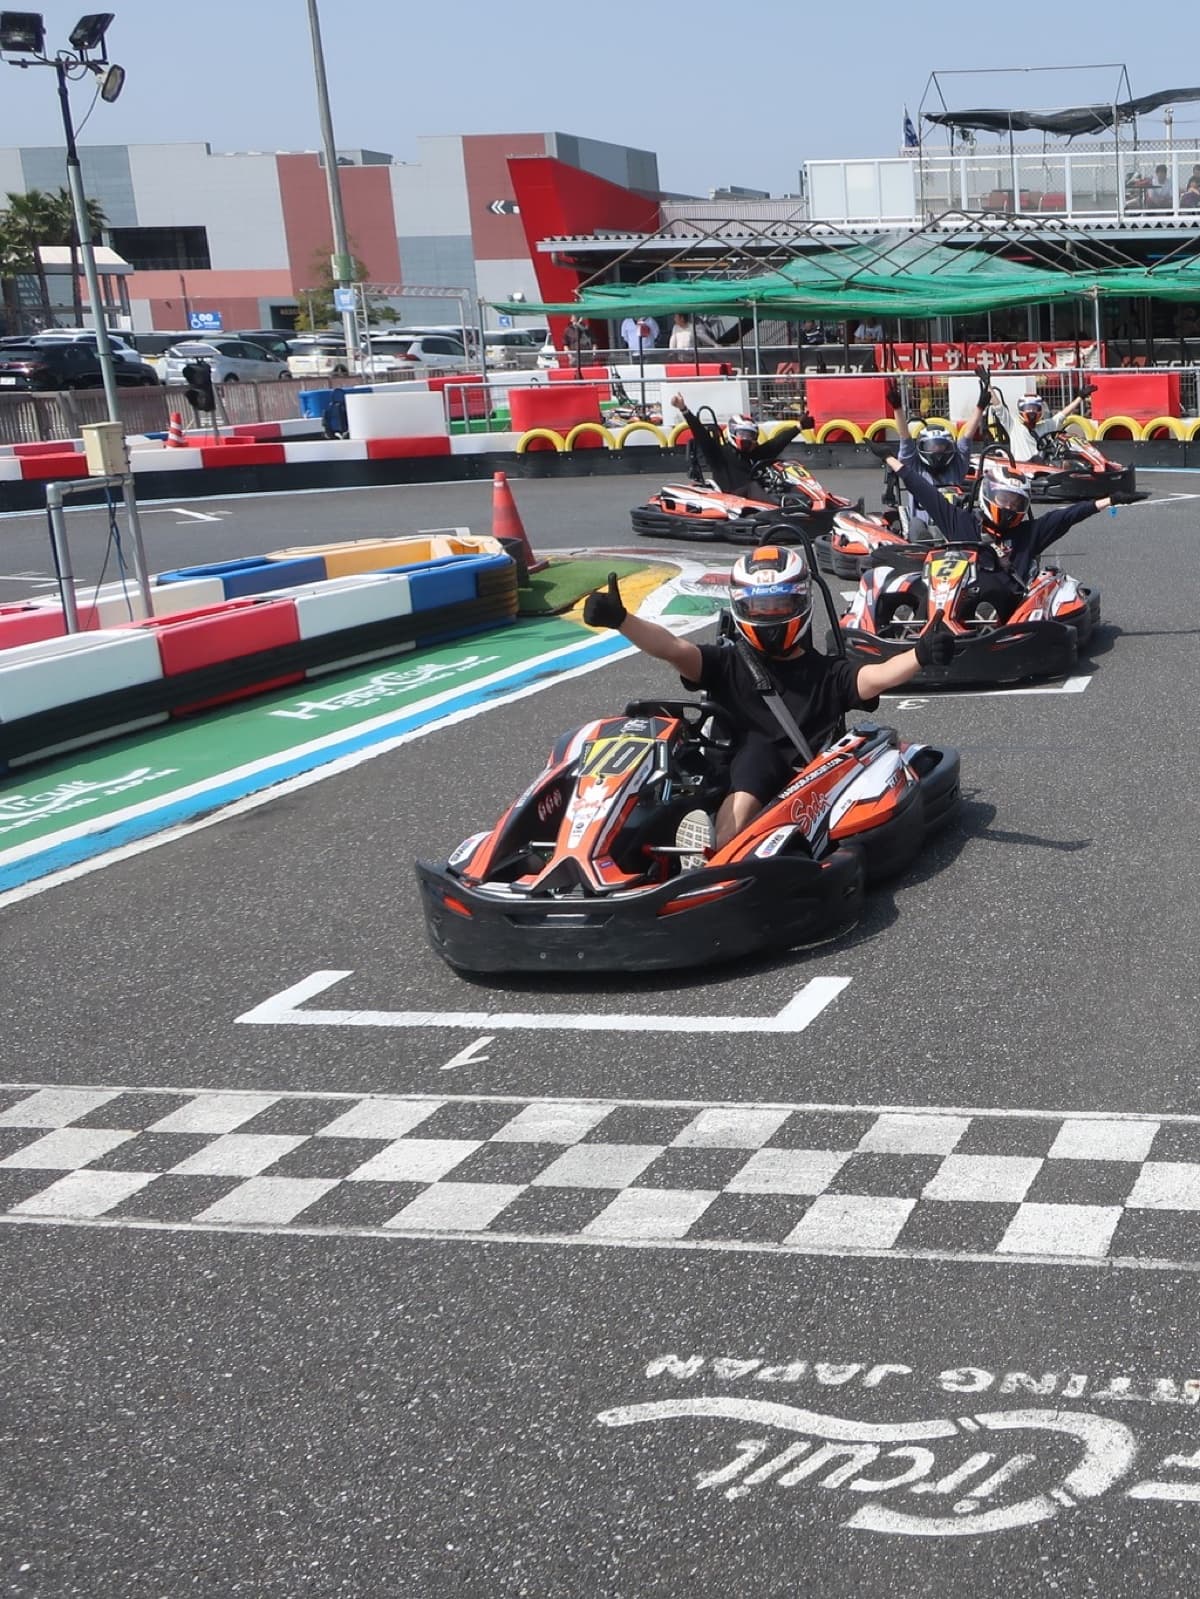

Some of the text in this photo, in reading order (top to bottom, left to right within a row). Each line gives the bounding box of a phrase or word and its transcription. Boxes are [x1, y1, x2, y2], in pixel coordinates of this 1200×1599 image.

[936, 560, 960, 577] 2
[581, 740, 650, 776] 10
[439, 1036, 497, 1071] 1
[646, 1354, 913, 1388] JAPAN
[596, 1396, 1138, 1536] Circuit
